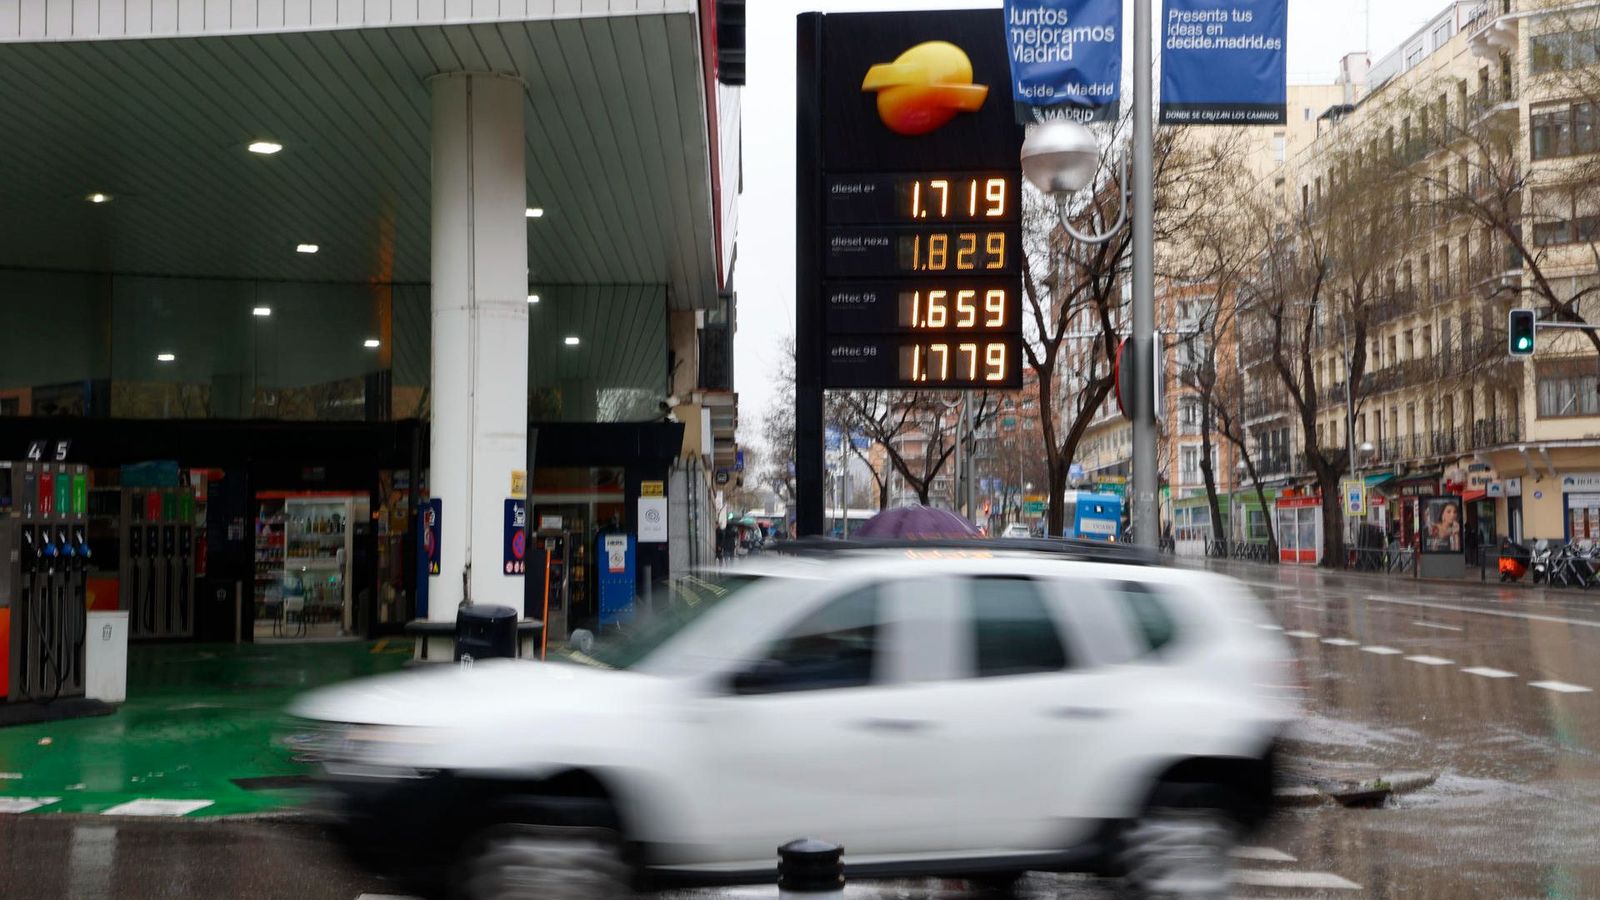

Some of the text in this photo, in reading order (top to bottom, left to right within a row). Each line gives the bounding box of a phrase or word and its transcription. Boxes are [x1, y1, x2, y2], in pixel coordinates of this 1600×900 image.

[1010, 5, 1068, 25] Juntos
[1168, 8, 1253, 23] Presenta tus
[1010, 25, 1115, 48] mejoramos
[1167, 22, 1223, 36] ideas en
[1166, 34, 1282, 50] decide.madrid.es
[1012, 42, 1073, 63] Madrid
[1044, 107, 1094, 124] MADRID
[1165, 110, 1280, 121] DONDE SE CRUZAN LOS CAMINOS
[831, 184, 862, 193] diesel
[912, 178, 1006, 218] 1.719
[831, 232, 1006, 271] diesel nexa 1.829
[831, 289, 1005, 328] efitec 95 1.659
[831, 343, 1006, 381] efitec 98 1.779
[28, 442, 41, 461] 4
[56, 441, 68, 461] 5
